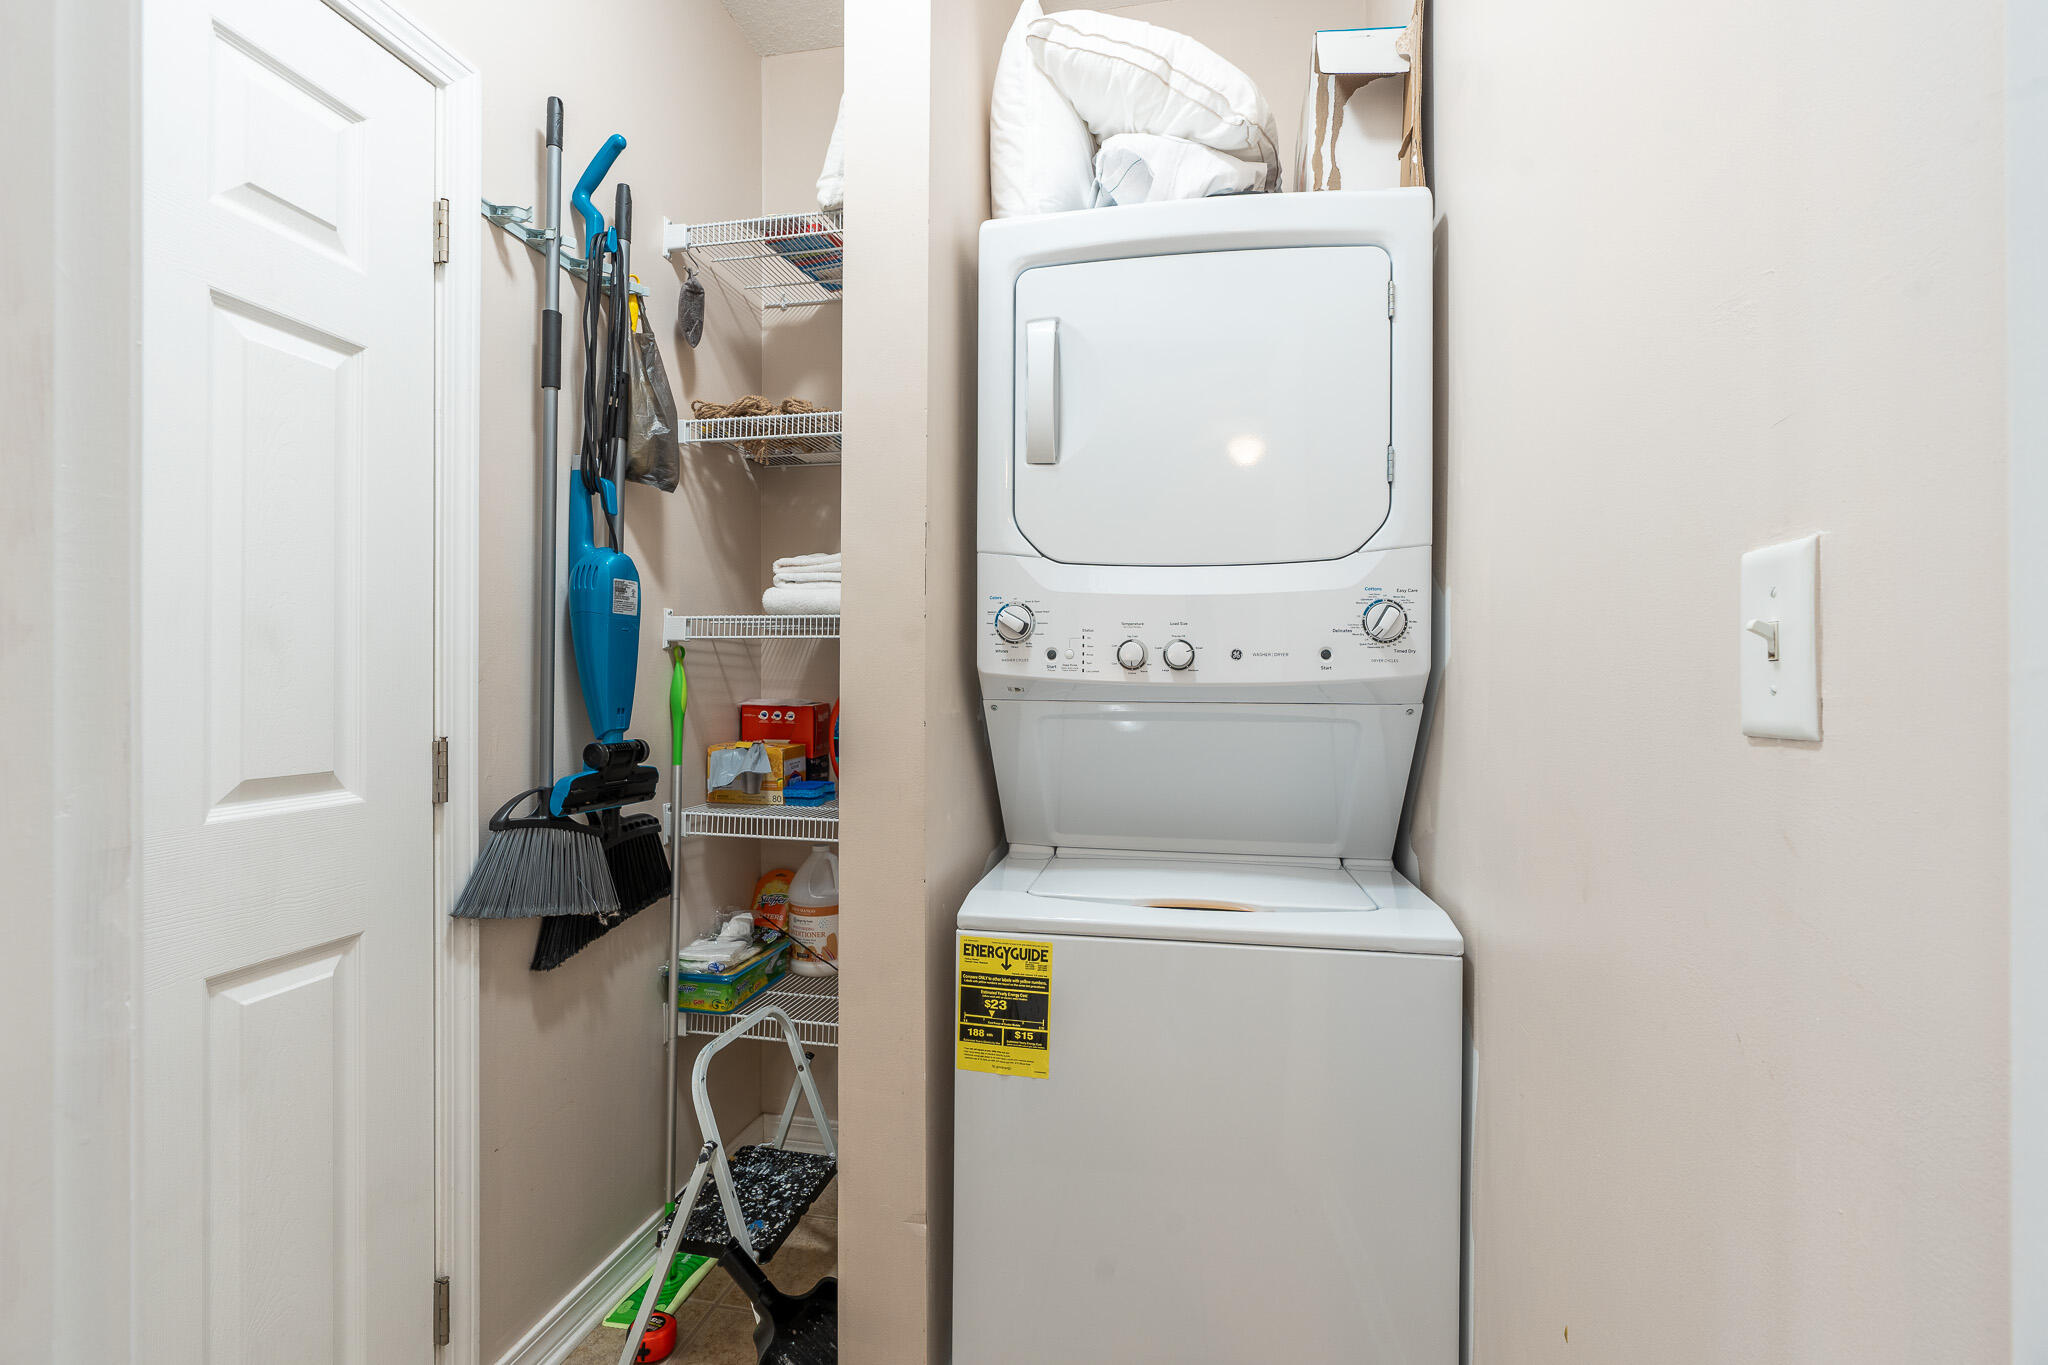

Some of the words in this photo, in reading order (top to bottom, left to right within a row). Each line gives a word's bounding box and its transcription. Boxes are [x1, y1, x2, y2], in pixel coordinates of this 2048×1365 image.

[963, 943, 1049, 962] ENERGYGUIDE
[984, 999, 1007, 1010] $23
[967, 1028, 985, 1037] 188
[1014, 1030, 1034, 1040] $15
